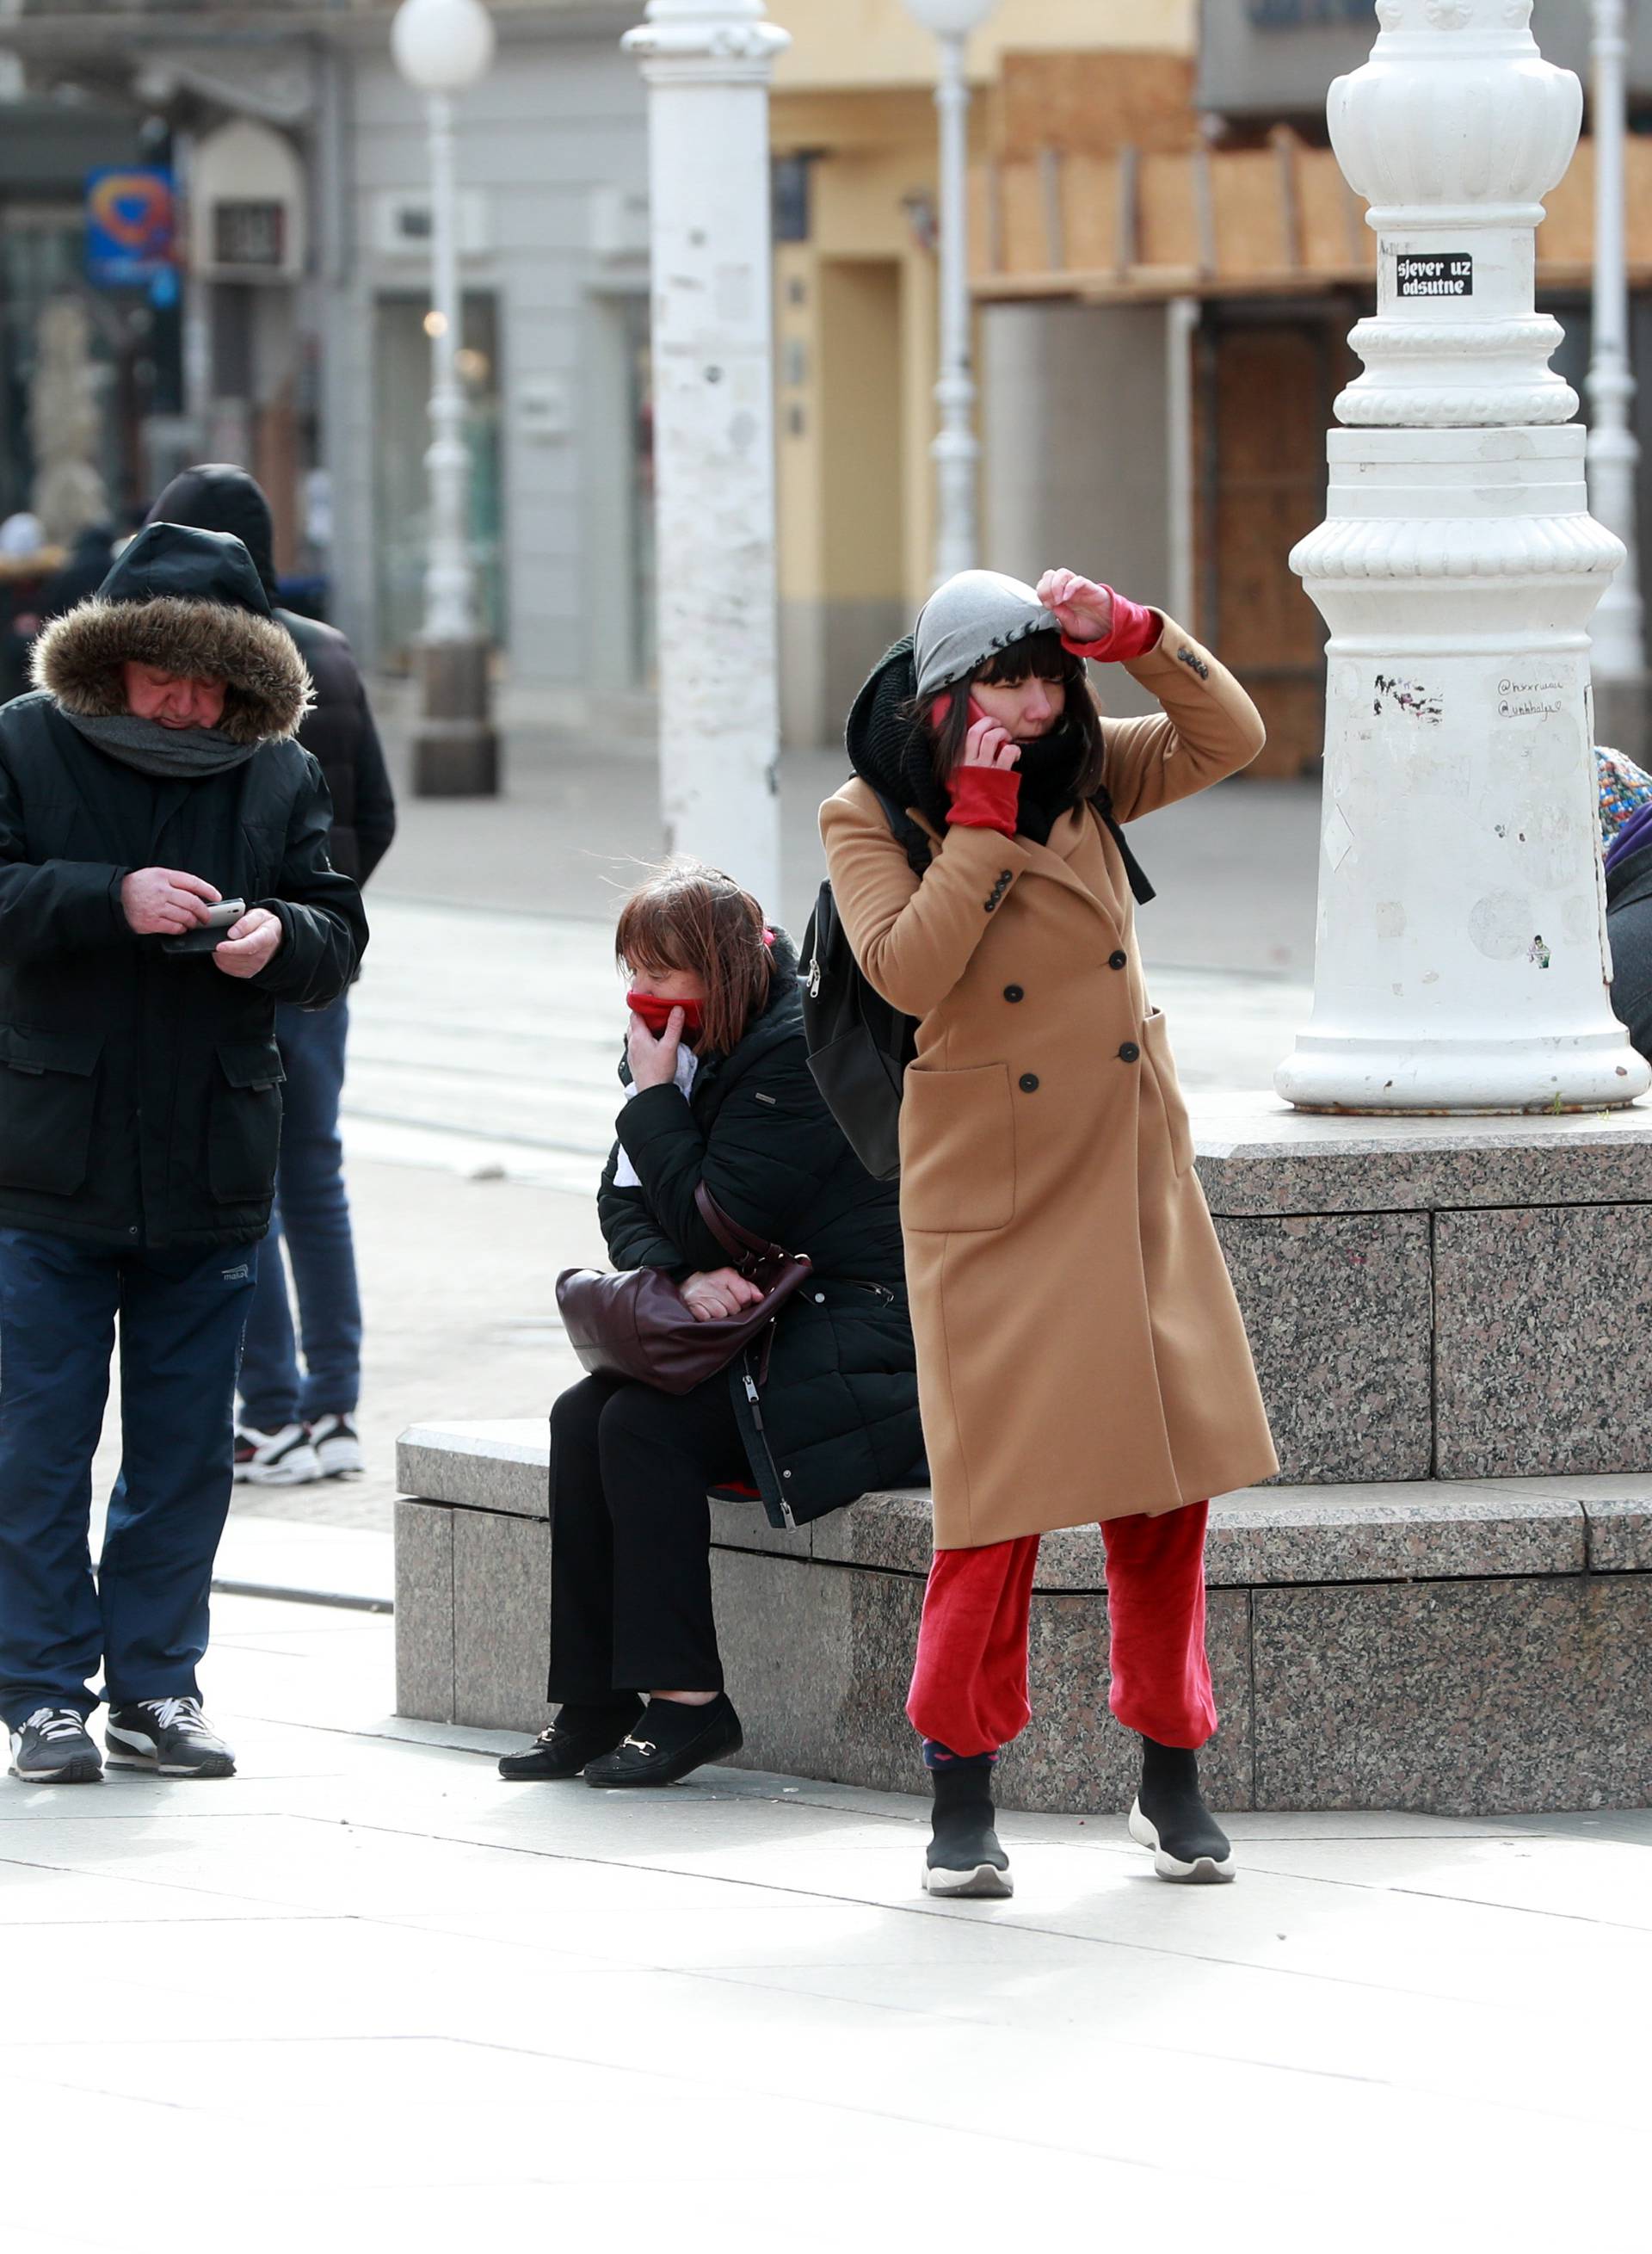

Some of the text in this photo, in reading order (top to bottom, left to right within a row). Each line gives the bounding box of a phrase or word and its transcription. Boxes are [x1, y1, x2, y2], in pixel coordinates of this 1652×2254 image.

[1397, 259, 1472, 280] sjever uz
[1402, 278, 1464, 295] odsutne
